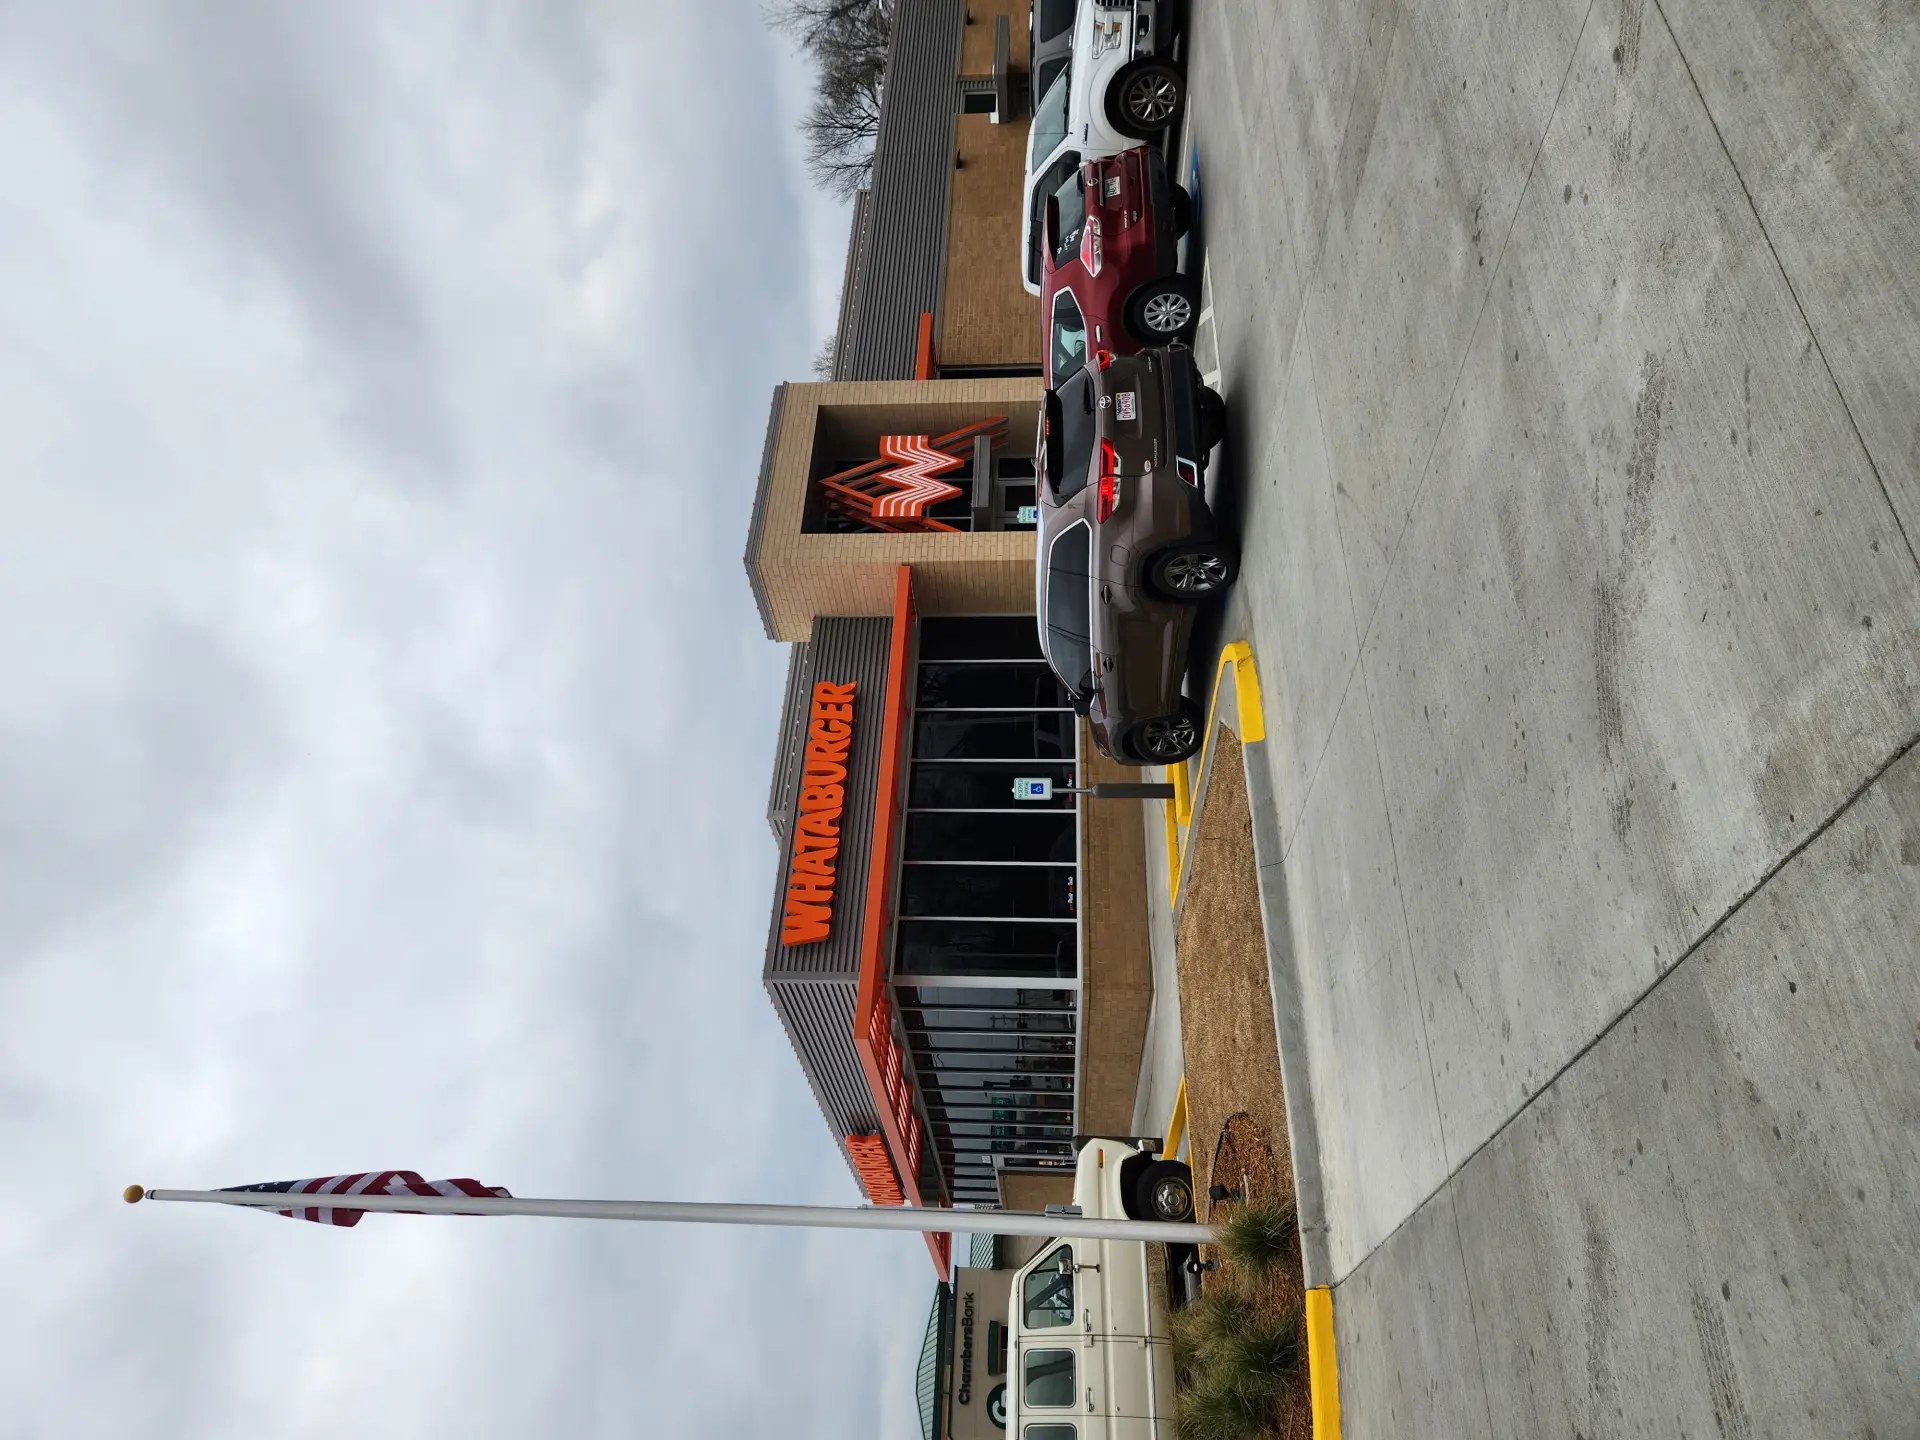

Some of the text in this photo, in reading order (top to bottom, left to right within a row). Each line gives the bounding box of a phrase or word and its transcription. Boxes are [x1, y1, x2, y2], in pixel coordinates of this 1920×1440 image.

[781, 681, 857, 947] WHATABURGER
[845, 1134, 904, 1206] WHATABURGER
[958, 1292, 974, 1405] ChambersBank
